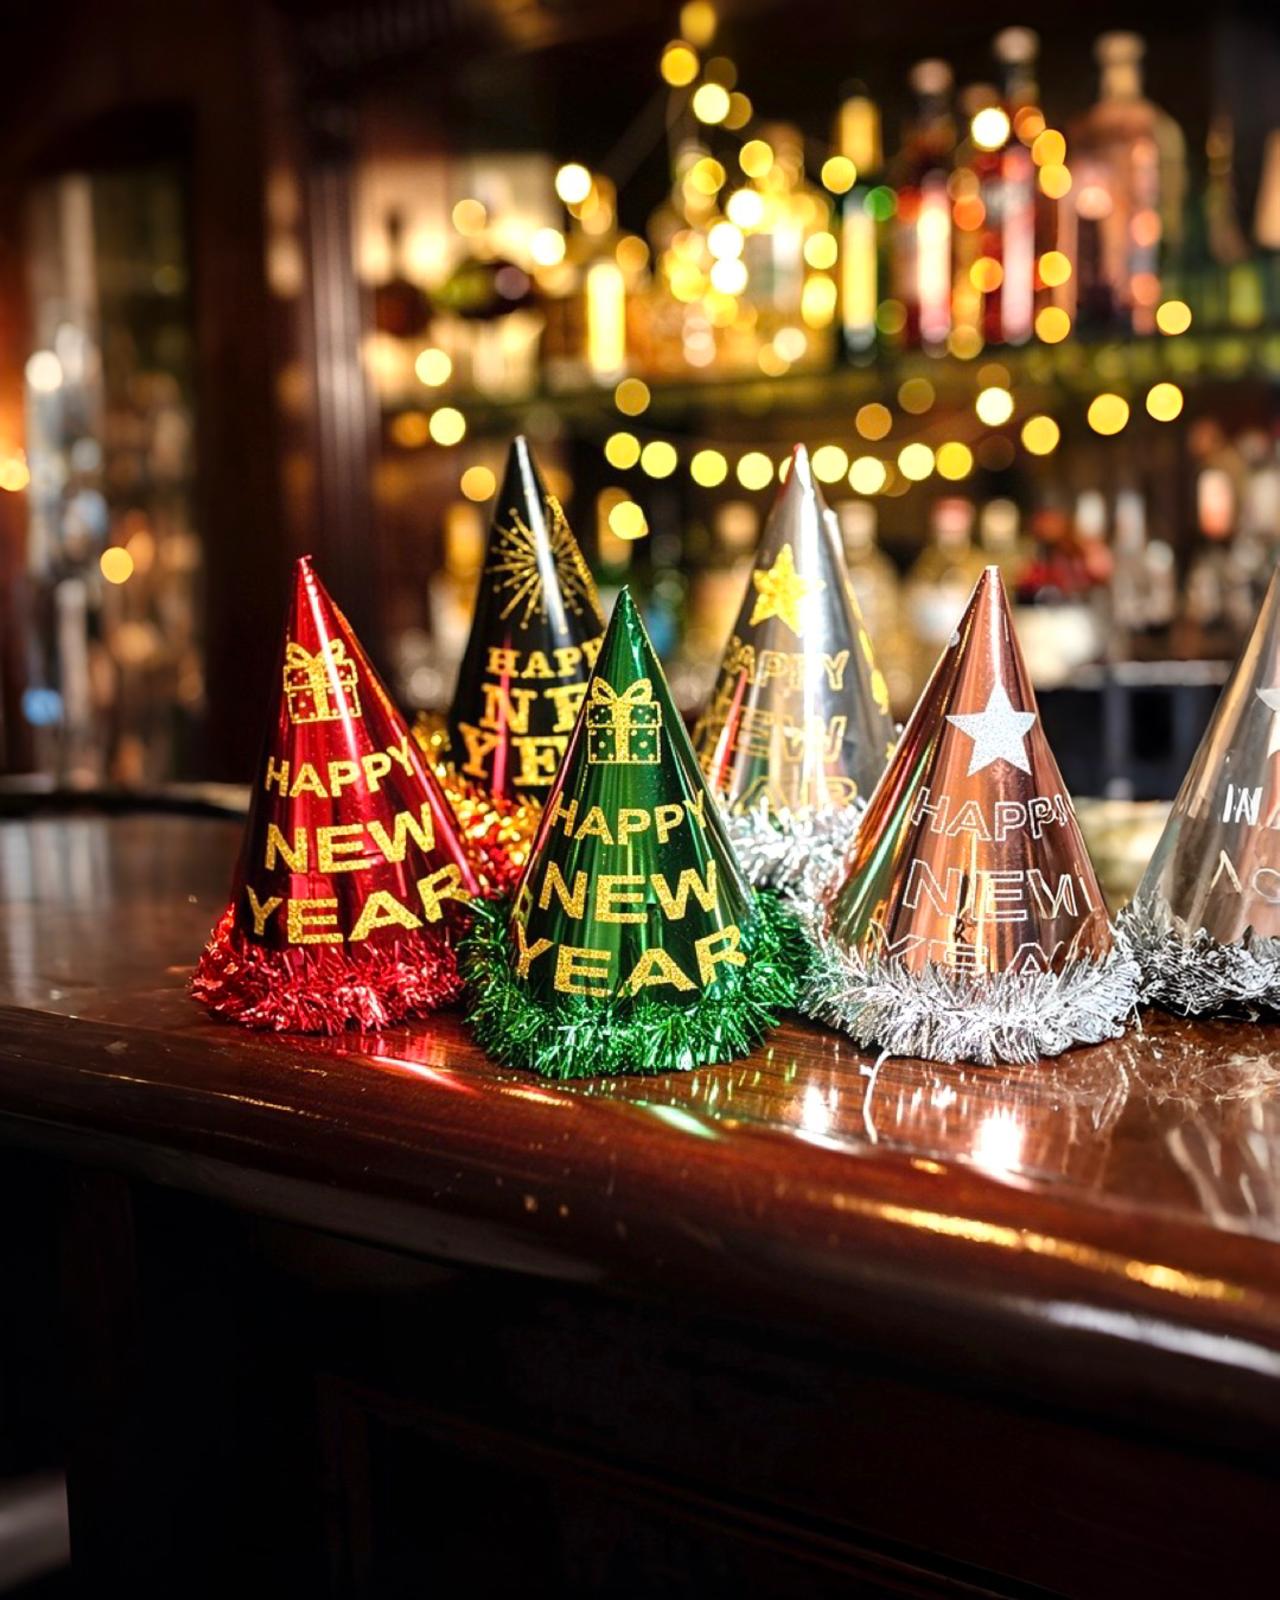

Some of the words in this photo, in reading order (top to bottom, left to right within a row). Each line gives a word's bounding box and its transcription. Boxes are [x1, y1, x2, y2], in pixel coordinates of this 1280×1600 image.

[480, 682, 589, 734] NE
[264, 736, 414, 799] HAPPY
[458, 721, 570, 787] YE
[264, 802, 436, 875] NEW
[549, 789, 707, 846] HAPPY
[245, 862, 472, 944] YEAR
[538, 859, 717, 924] NEW
[515, 920, 747, 998] YEAR
